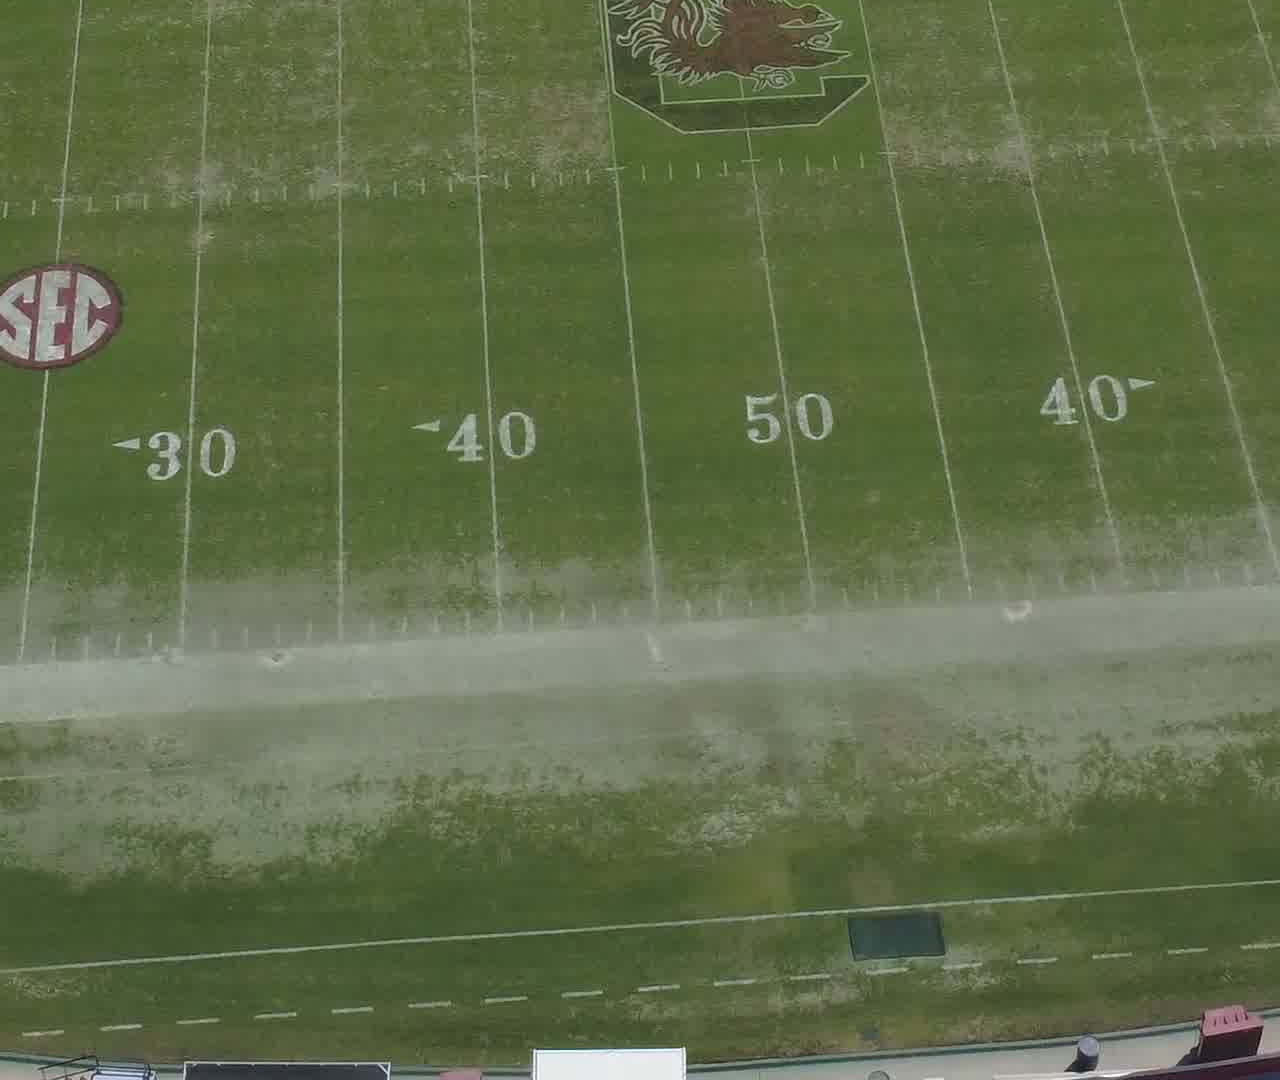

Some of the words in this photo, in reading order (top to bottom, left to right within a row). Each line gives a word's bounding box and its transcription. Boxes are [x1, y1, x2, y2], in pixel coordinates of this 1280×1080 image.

[744, 391, 835, 444] 50
[1039, 374, 1131, 426] 40
[145, 427, 237, 481] 30
[446, 410, 538, 463] 40
